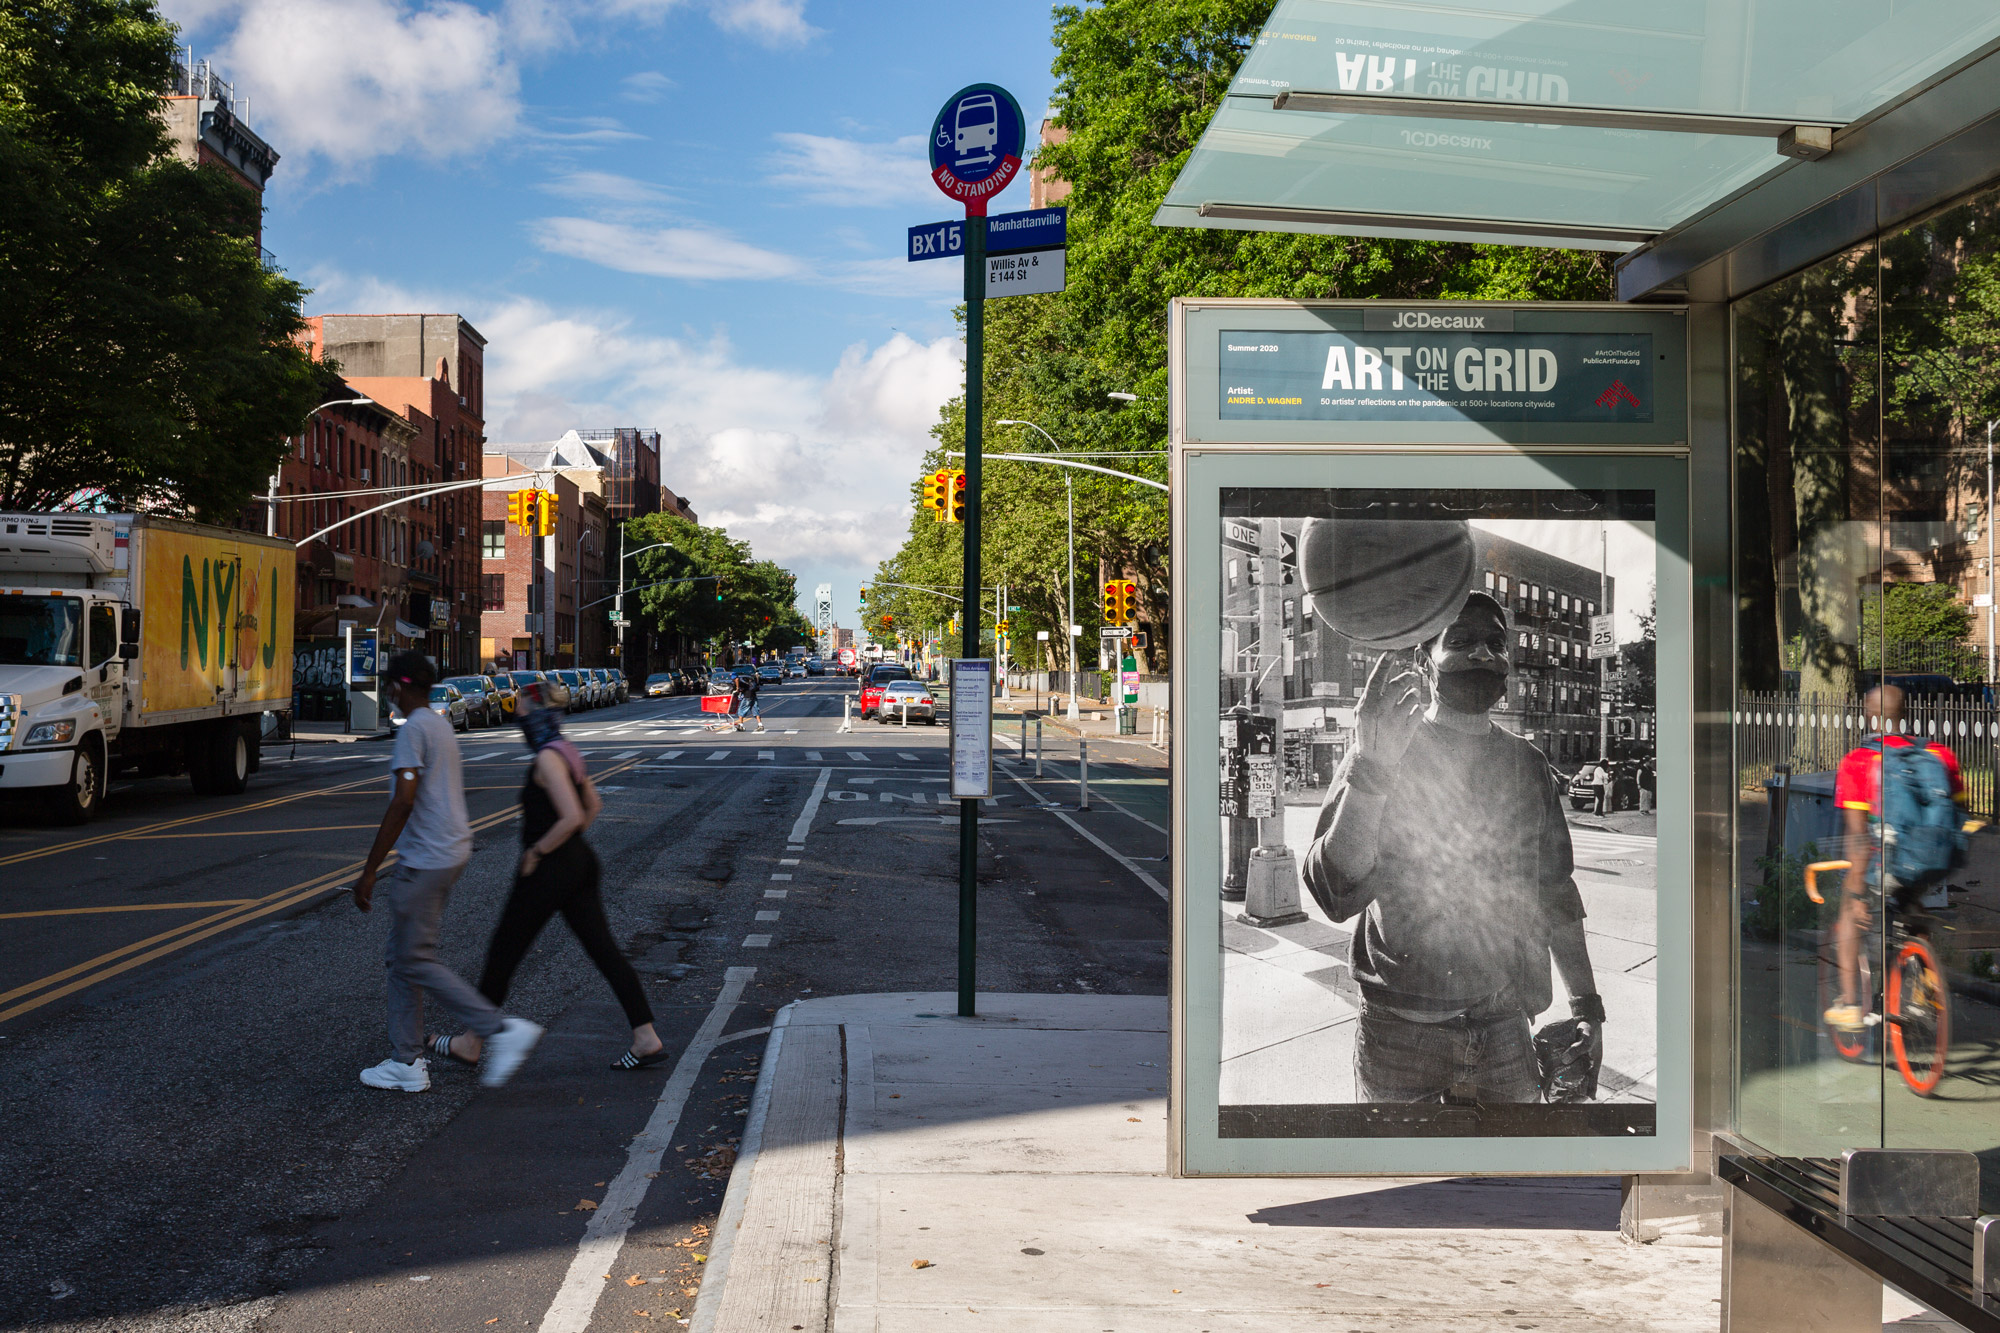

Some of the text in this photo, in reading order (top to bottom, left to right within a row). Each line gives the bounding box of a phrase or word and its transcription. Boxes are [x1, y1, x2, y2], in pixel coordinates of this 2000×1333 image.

[938, 160, 1014, 197] NO STANDING
[990, 213, 1061, 232] Manhattanville
[912, 226, 961, 255] BX15
[990, 256, 1039, 271] Willis Av &
[990, 269, 1027, 283] E 144 St
[1392, 312, 1485, 329] JCDecaux
[1416, 347, 1447, 370] ON
[1321, 346, 1411, 390] ART
[1454, 347, 1558, 392] GRID
[1227, 387, 1254, 395] Artist:
[1415, 373, 1449, 391] THE
[1595, 379, 1623, 407] PUBLIC
[1422, 399, 1458, 408] pandemic
[1524, 400, 1555, 408] citywide
[1232, 526, 1256, 544] ONE
[1594, 632, 1612, 645] 25
